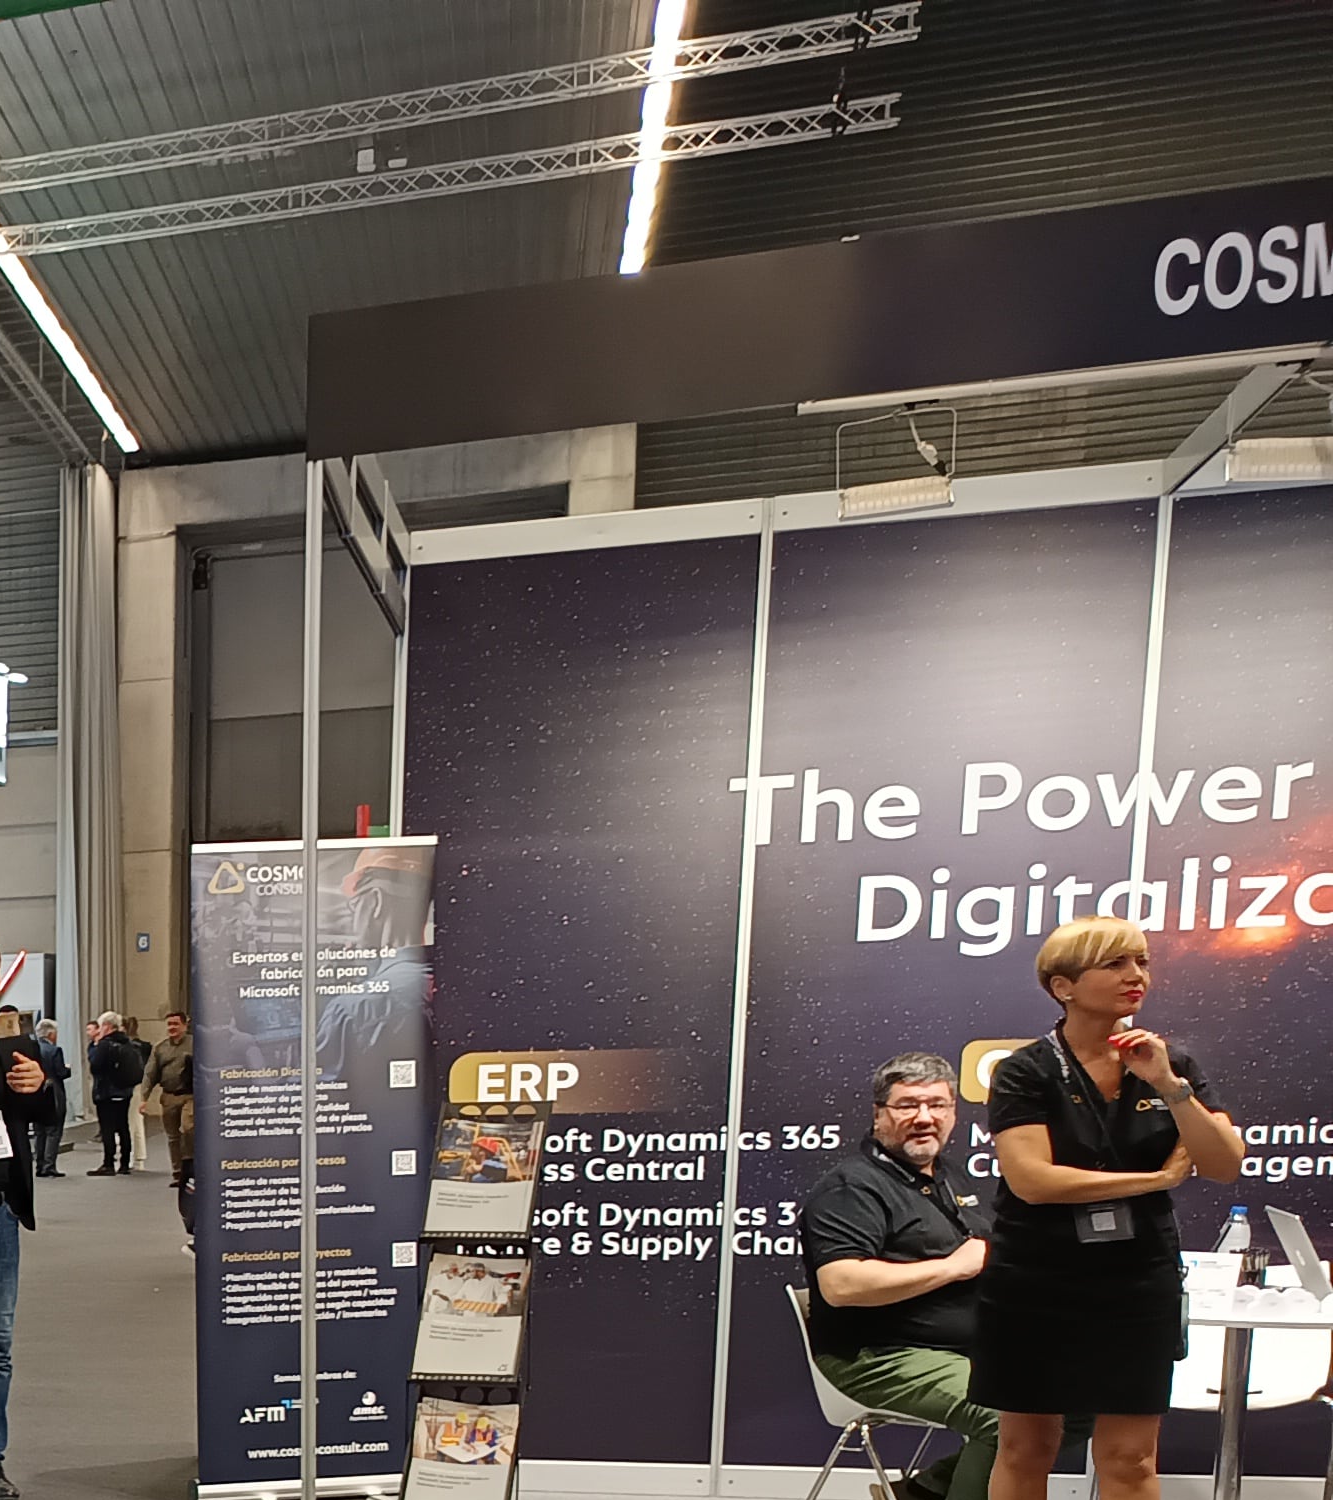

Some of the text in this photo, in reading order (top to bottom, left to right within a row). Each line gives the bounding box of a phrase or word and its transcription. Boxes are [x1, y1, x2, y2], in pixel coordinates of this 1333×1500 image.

[1154, 221, 1333, 316] COSM
[728, 760, 1316, 846] The Power
[256, 883, 303, 897] CONSU
[138, 936, 148, 949] 6
[232, 945, 398, 966] Expertos oluciones de
[336, 967, 368, 982] para
[239, 981, 390, 999] Microsoft namics 365
[220, 1067, 323, 1079] Fabricación Disca
[476, 1061, 580, 1102] ERP
[602, 1128, 772, 1157] Dynamics
[780, 1124, 841, 1151] 365
[221, 1158, 280, 1170] Fabricación
[281, 1159, 299, 1169] por
[584, 1155, 705, 1182] Central
[599, 1202, 768, 1232] Dynamics
[570, 1233, 593, 1256] &
[601, 1231, 714, 1261] Supply
[222, 1250, 300, 1263] Fabricación por
[239, 1406, 286, 1424] AFM
